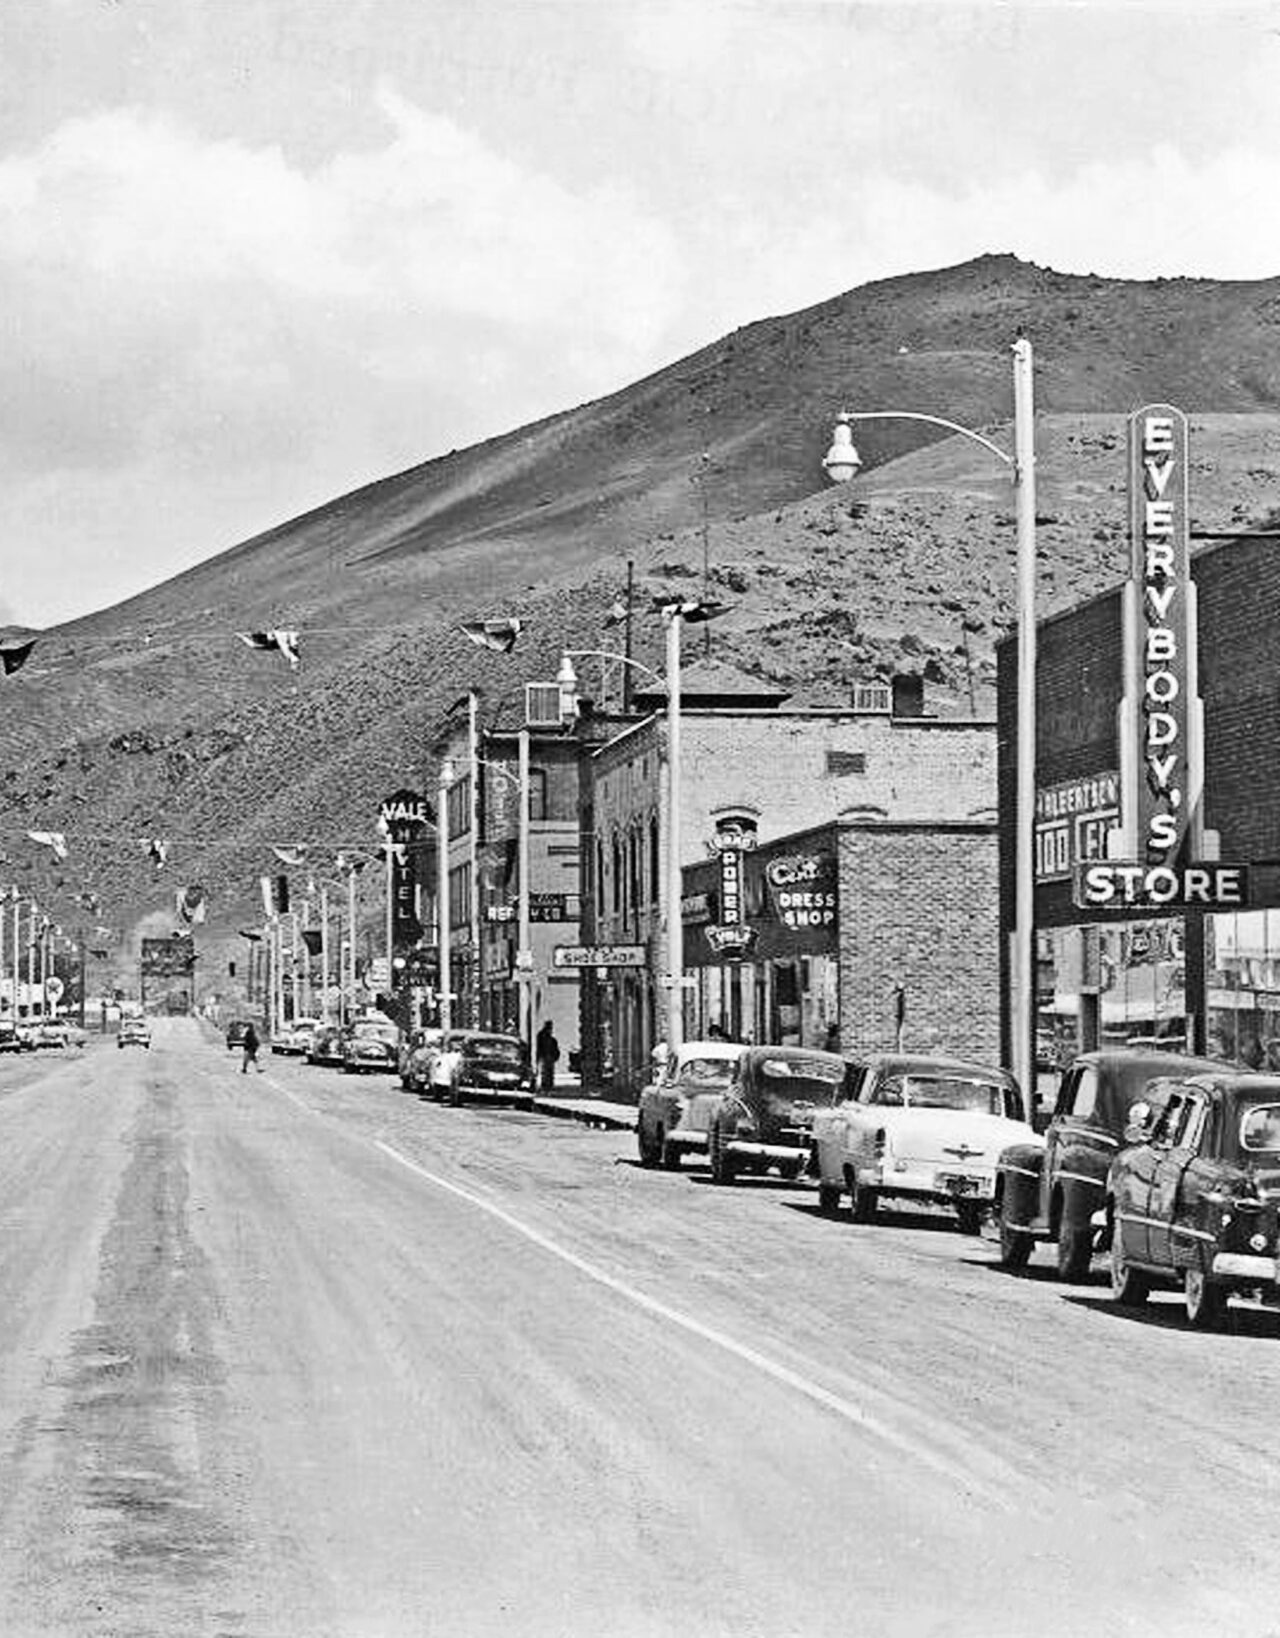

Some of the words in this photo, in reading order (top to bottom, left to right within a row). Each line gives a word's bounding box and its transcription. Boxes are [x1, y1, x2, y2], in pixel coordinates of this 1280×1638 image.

[1144, 417, 1182, 849] EVERYBODY'S
[381, 802, 426, 820] VALE
[1086, 866, 1241, 902] STORE
[779, 892, 836, 908] DRESS
[784, 909, 835, 926] SHOP
